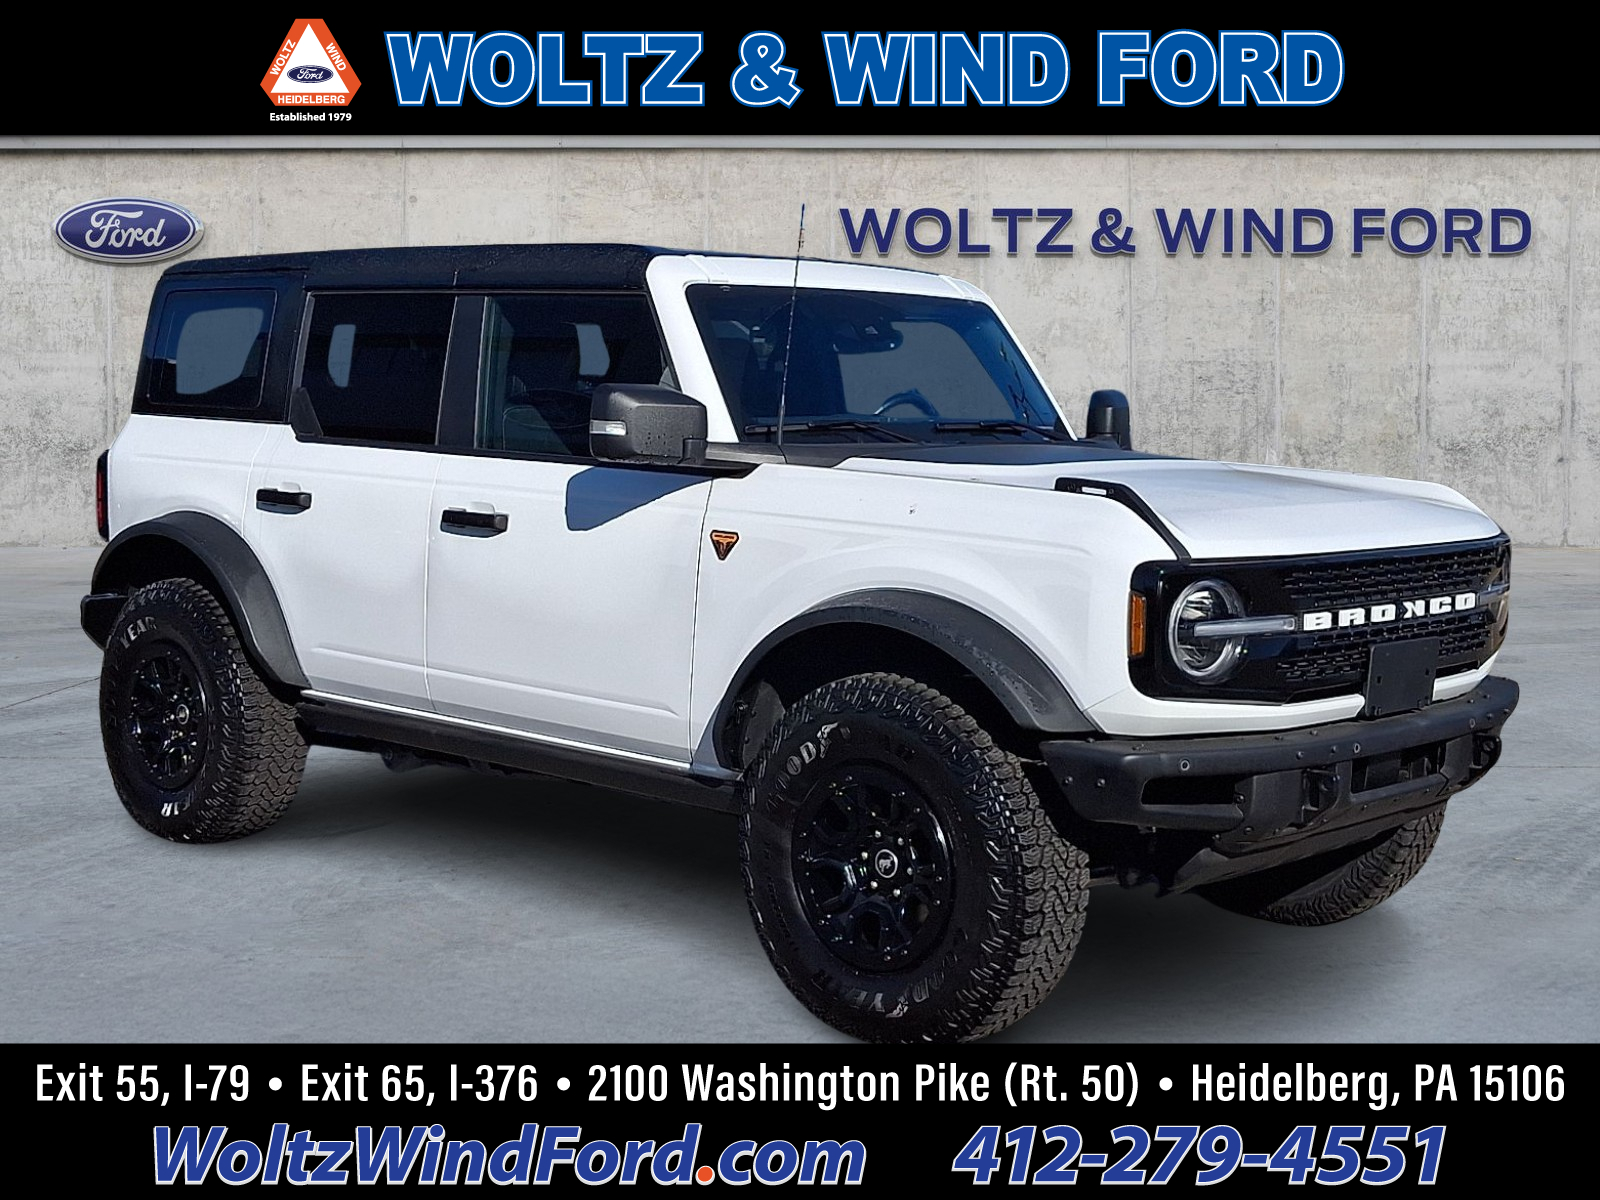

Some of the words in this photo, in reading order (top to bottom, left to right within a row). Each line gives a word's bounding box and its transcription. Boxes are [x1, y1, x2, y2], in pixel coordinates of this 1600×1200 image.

[84, 209, 166, 249] Ford
[840, 207, 1073, 254] WOLTZ
[1091, 207, 1137, 254] &
[1156, 207, 1334, 254] WIND
[1353, 207, 1532, 254] FORD
[1303, 591, 1477, 632] BRONCO
